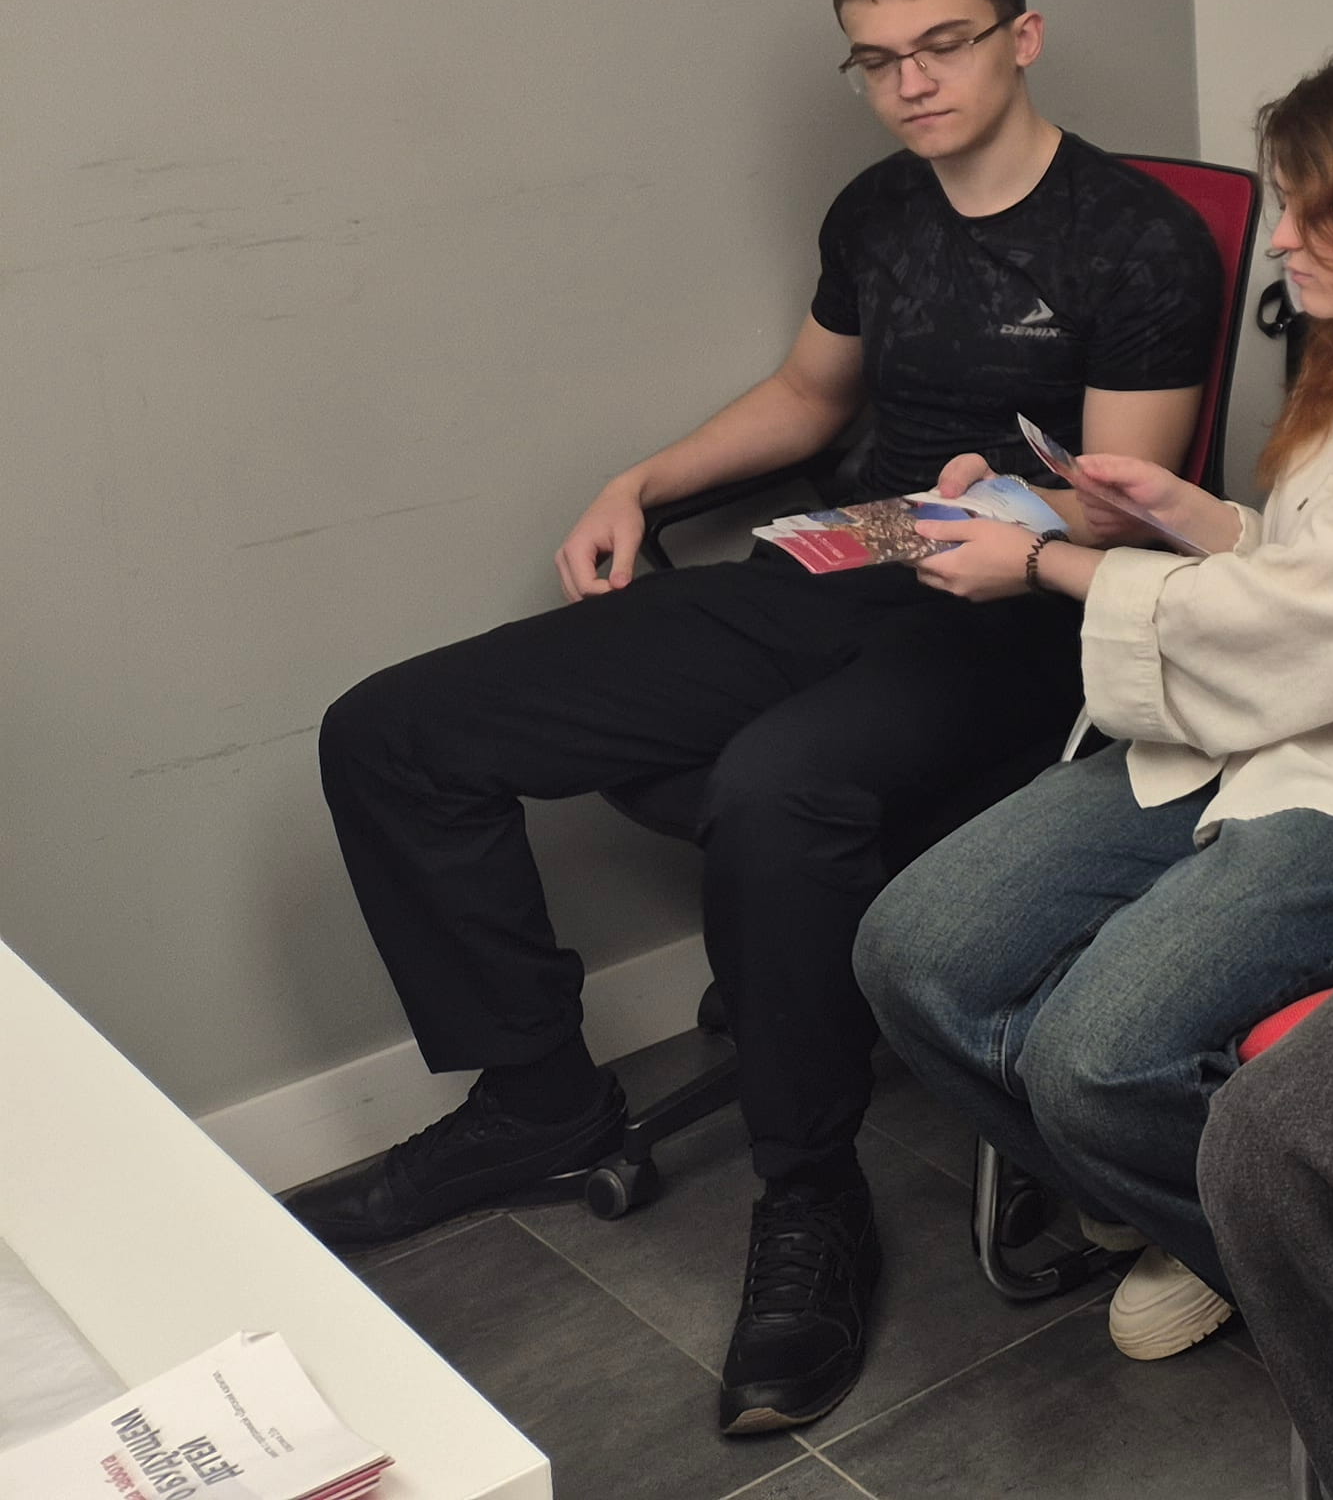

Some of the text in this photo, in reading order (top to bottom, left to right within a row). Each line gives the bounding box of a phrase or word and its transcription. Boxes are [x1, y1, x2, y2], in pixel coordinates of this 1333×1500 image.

[1000, 324, 1061, 338] DEMIX
[111, 1407, 188, 1495] БУДУЩЕМ
[177, 1435, 245, 1487] ДЕТЕЙ
